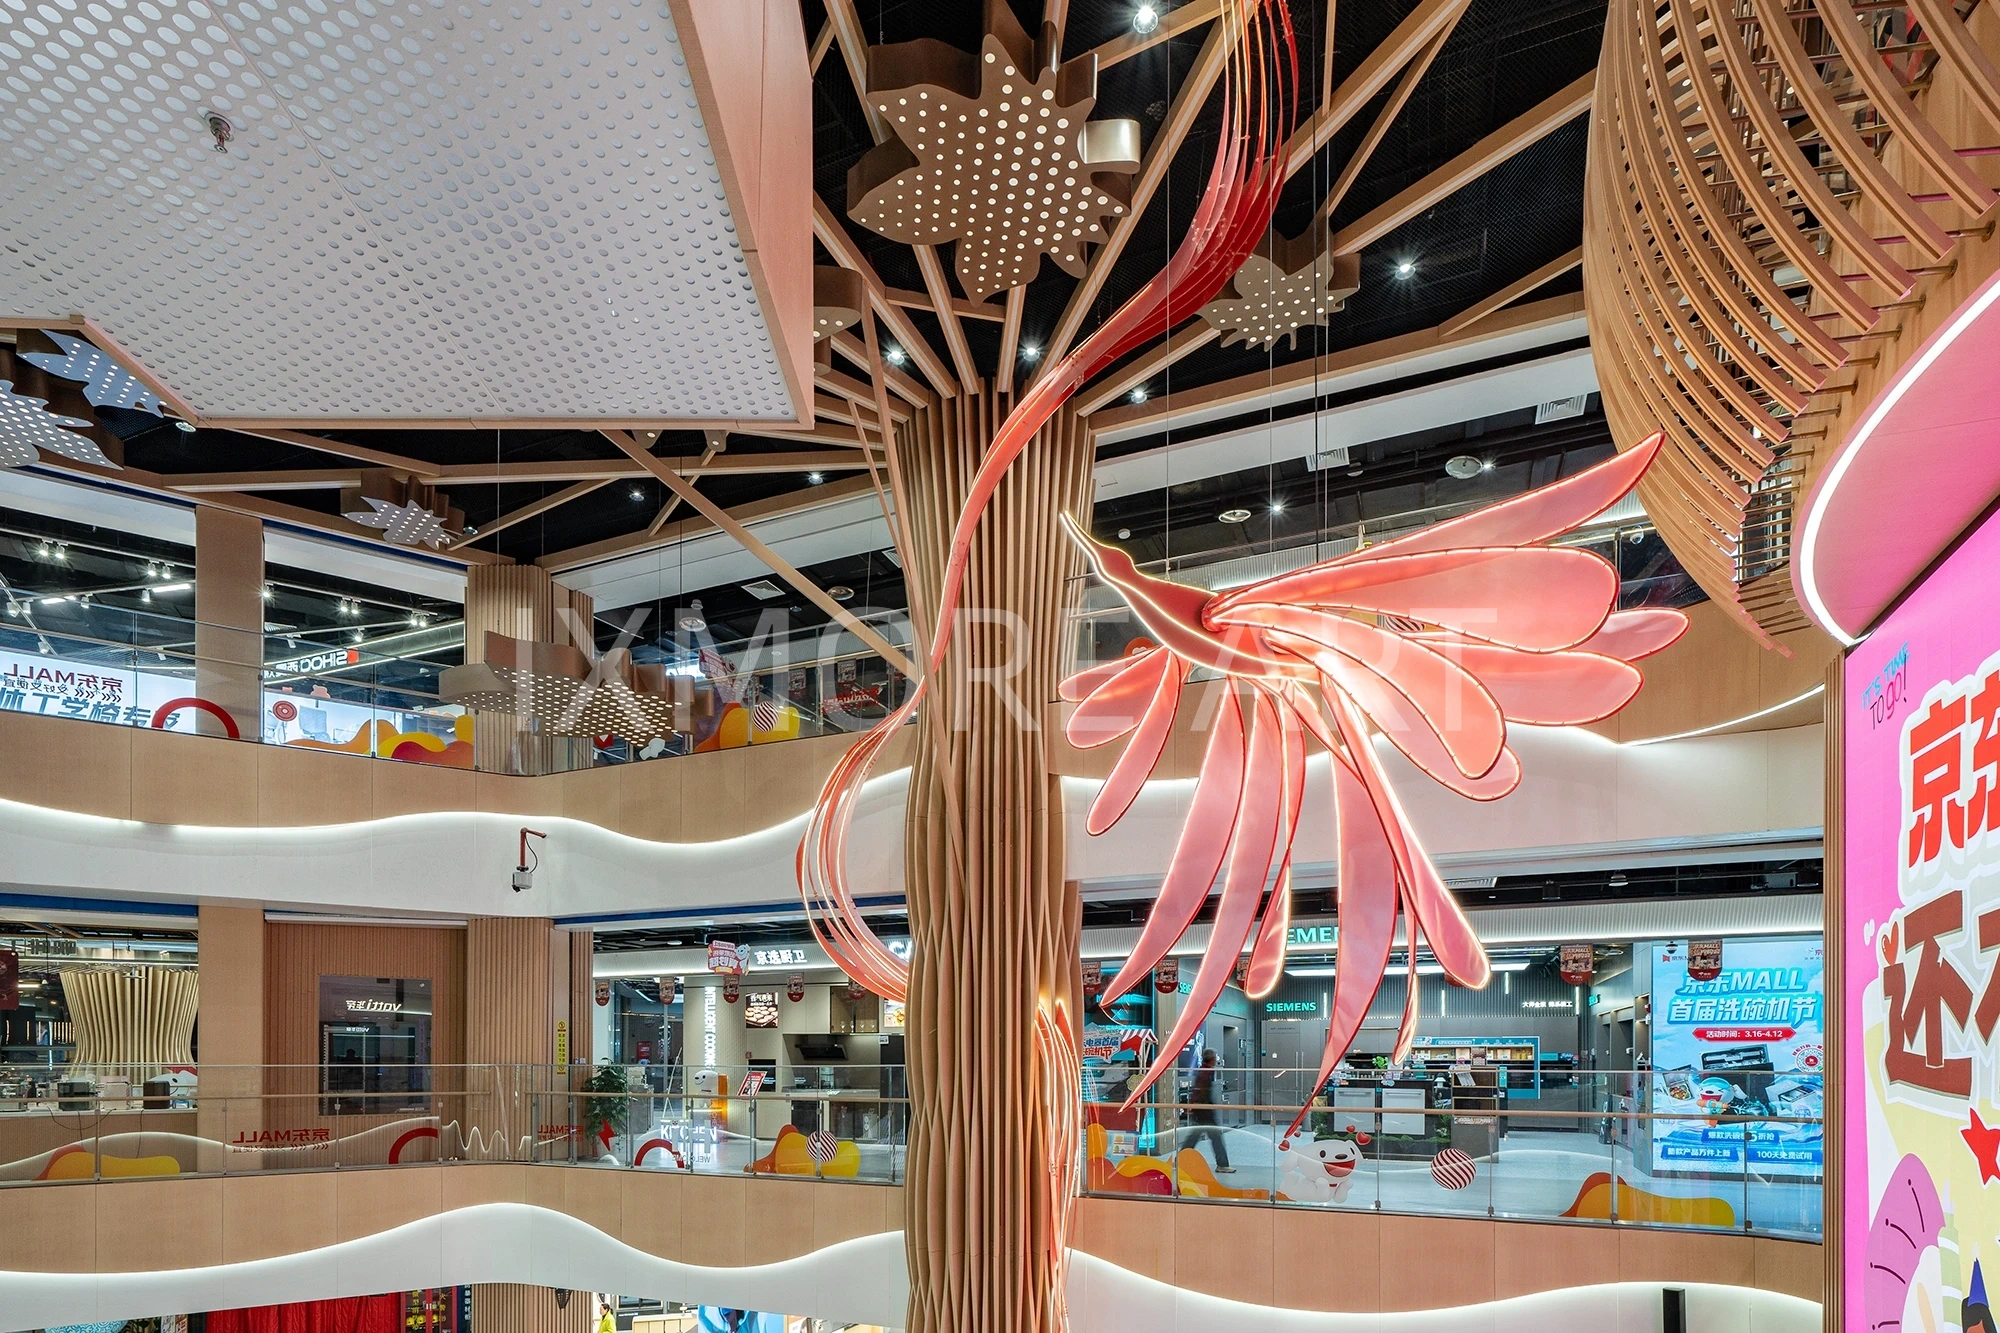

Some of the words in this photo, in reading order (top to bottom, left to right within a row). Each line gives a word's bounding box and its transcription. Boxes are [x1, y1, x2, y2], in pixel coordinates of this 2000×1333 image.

[1862, 675, 1881, 711] IT'S
[1883, 641, 1911, 683] TIME
[1870, 694, 1885, 731] TO
[754, 949, 807, 965] 京选厨卫
[1681, 970, 1804, 994] 京东MALL
[1266, 1002, 1317, 1012] SIEMENS
[1669, 996, 1816, 1027] 首届洗碗机节
[1084, 1036, 1119, 1047] 电器首届
[1083, 1046, 1113, 1060] 碗机节
[1708, 1130, 1775, 1142] 爆款洗碗5折抢
[1757, 1150, 1813, 1160] 100天免费试用
